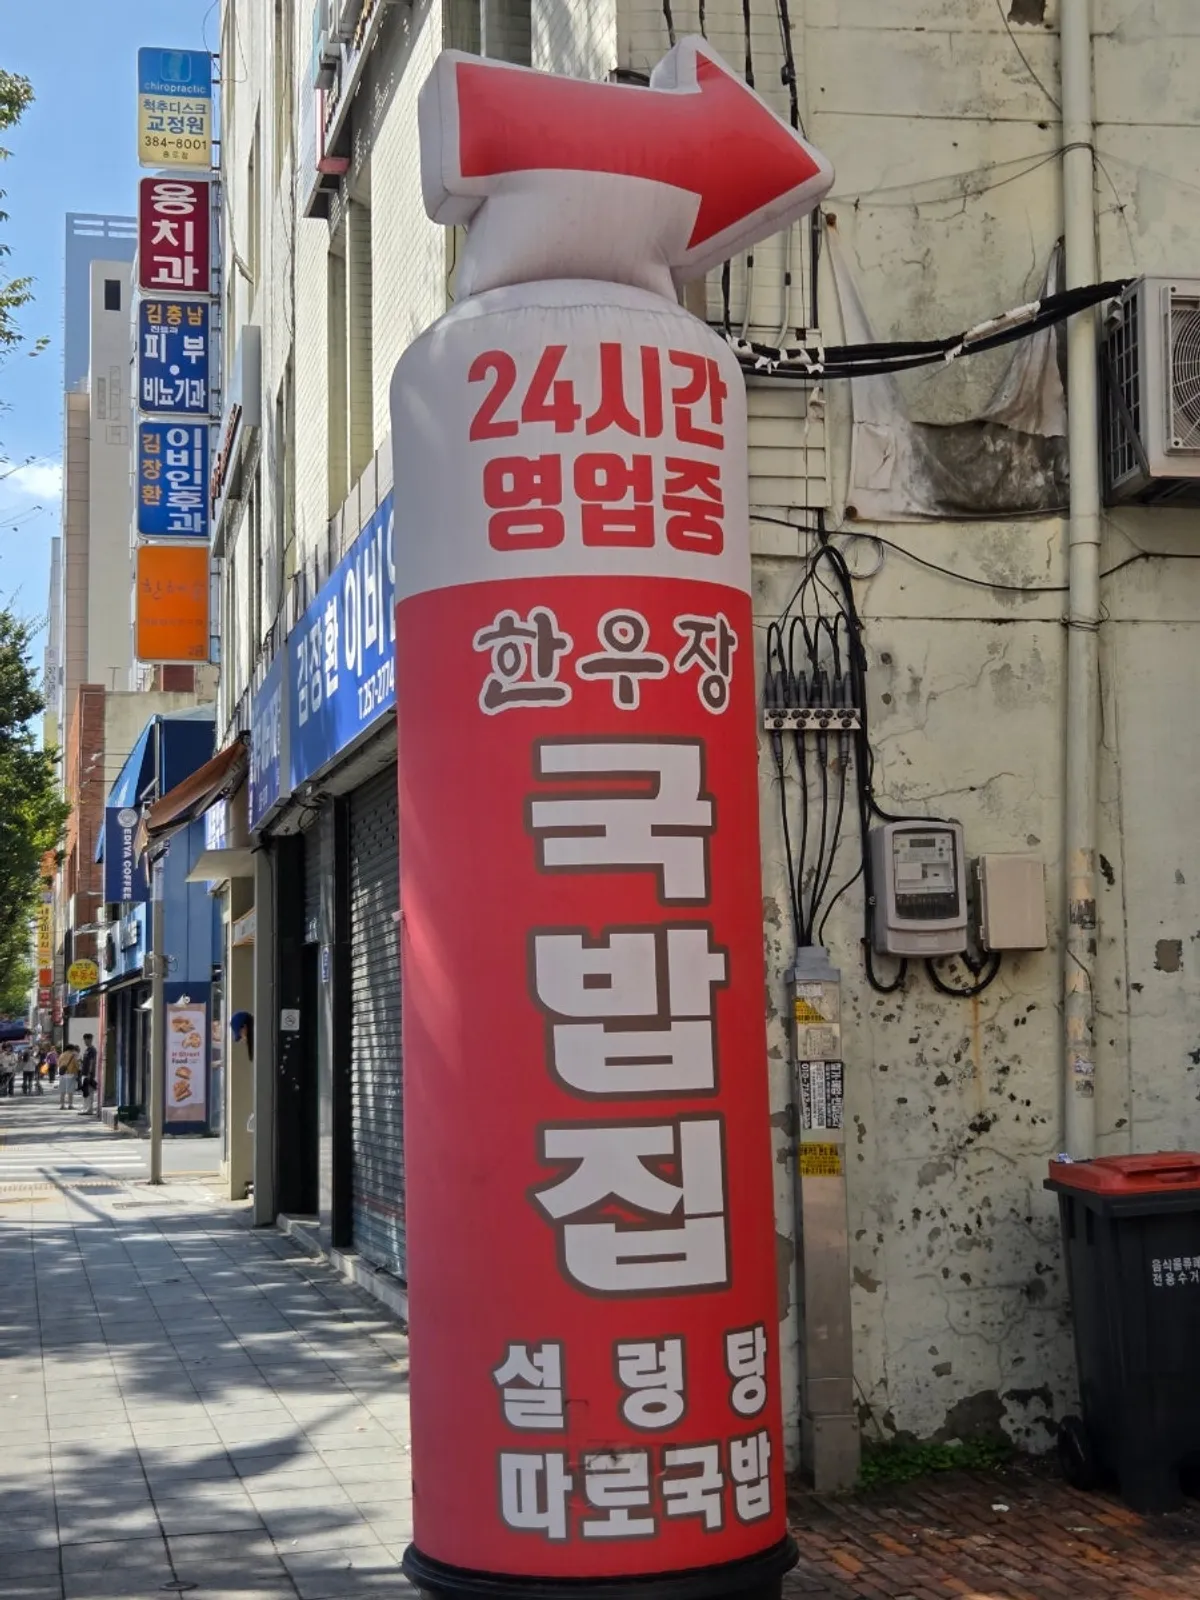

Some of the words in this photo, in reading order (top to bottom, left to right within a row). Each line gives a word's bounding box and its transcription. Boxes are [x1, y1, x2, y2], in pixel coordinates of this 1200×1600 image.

[144, 81, 206, 93] chiropractic
[144, 99, 207, 114] 척추디스크
[145, 135, 207, 150] 384-8001
[147, 115, 204, 135] 교정원
[151, 183, 199, 287] 용치과
[146, 303, 204, 326] 김충남
[144, 333, 205, 364] 피부
[143, 376, 206, 408] 비뇨기과
[467, 342, 727, 450] 24시간
[165, 428, 206, 532] 이비인후과
[483, 452, 725, 556] 영업중
[297, 595, 338, 728] 김장환
[473, 605, 738, 715] 한우장
[123, 828, 132, 858] EDIYA
[123, 860, 132, 899] COFFEE
[528, 738, 731, 1294] 국밥집
[1152, 1269, 1199, 1286] 전용수거
[493, 1322, 768, 1432] 설렁탕
[498, 1430, 772, 1539] 따로국밥
